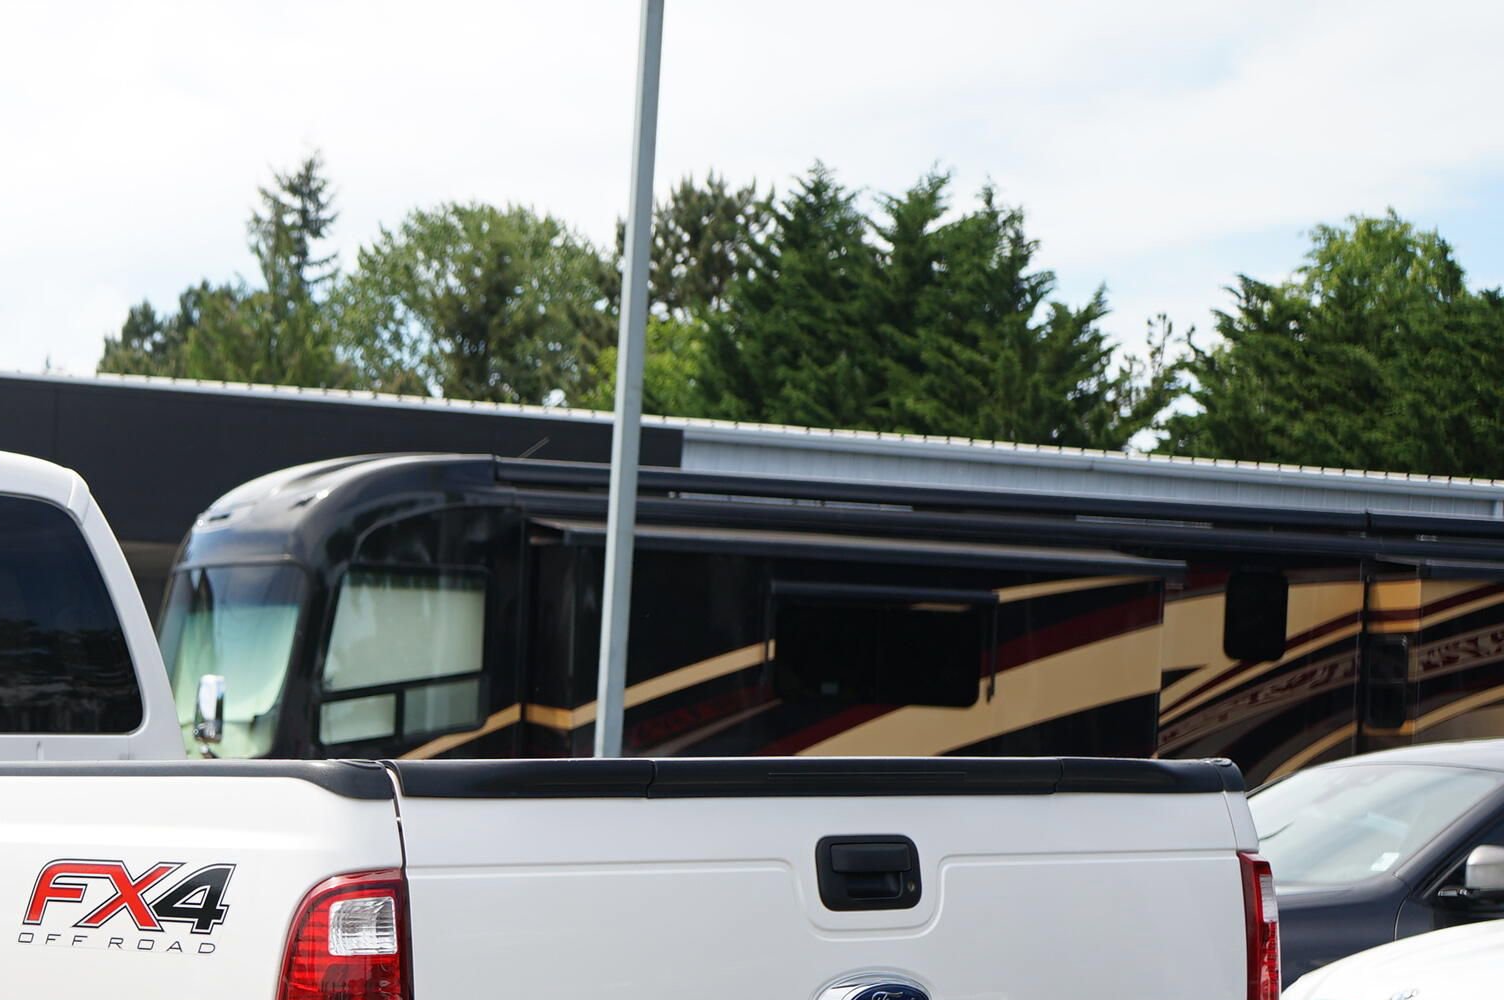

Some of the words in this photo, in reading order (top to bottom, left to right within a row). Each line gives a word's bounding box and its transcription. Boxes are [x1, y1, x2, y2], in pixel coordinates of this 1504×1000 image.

[23, 858, 237, 935] FX4
[18, 931, 88, 946] OFF
[108, 937, 216, 954] ROAD
